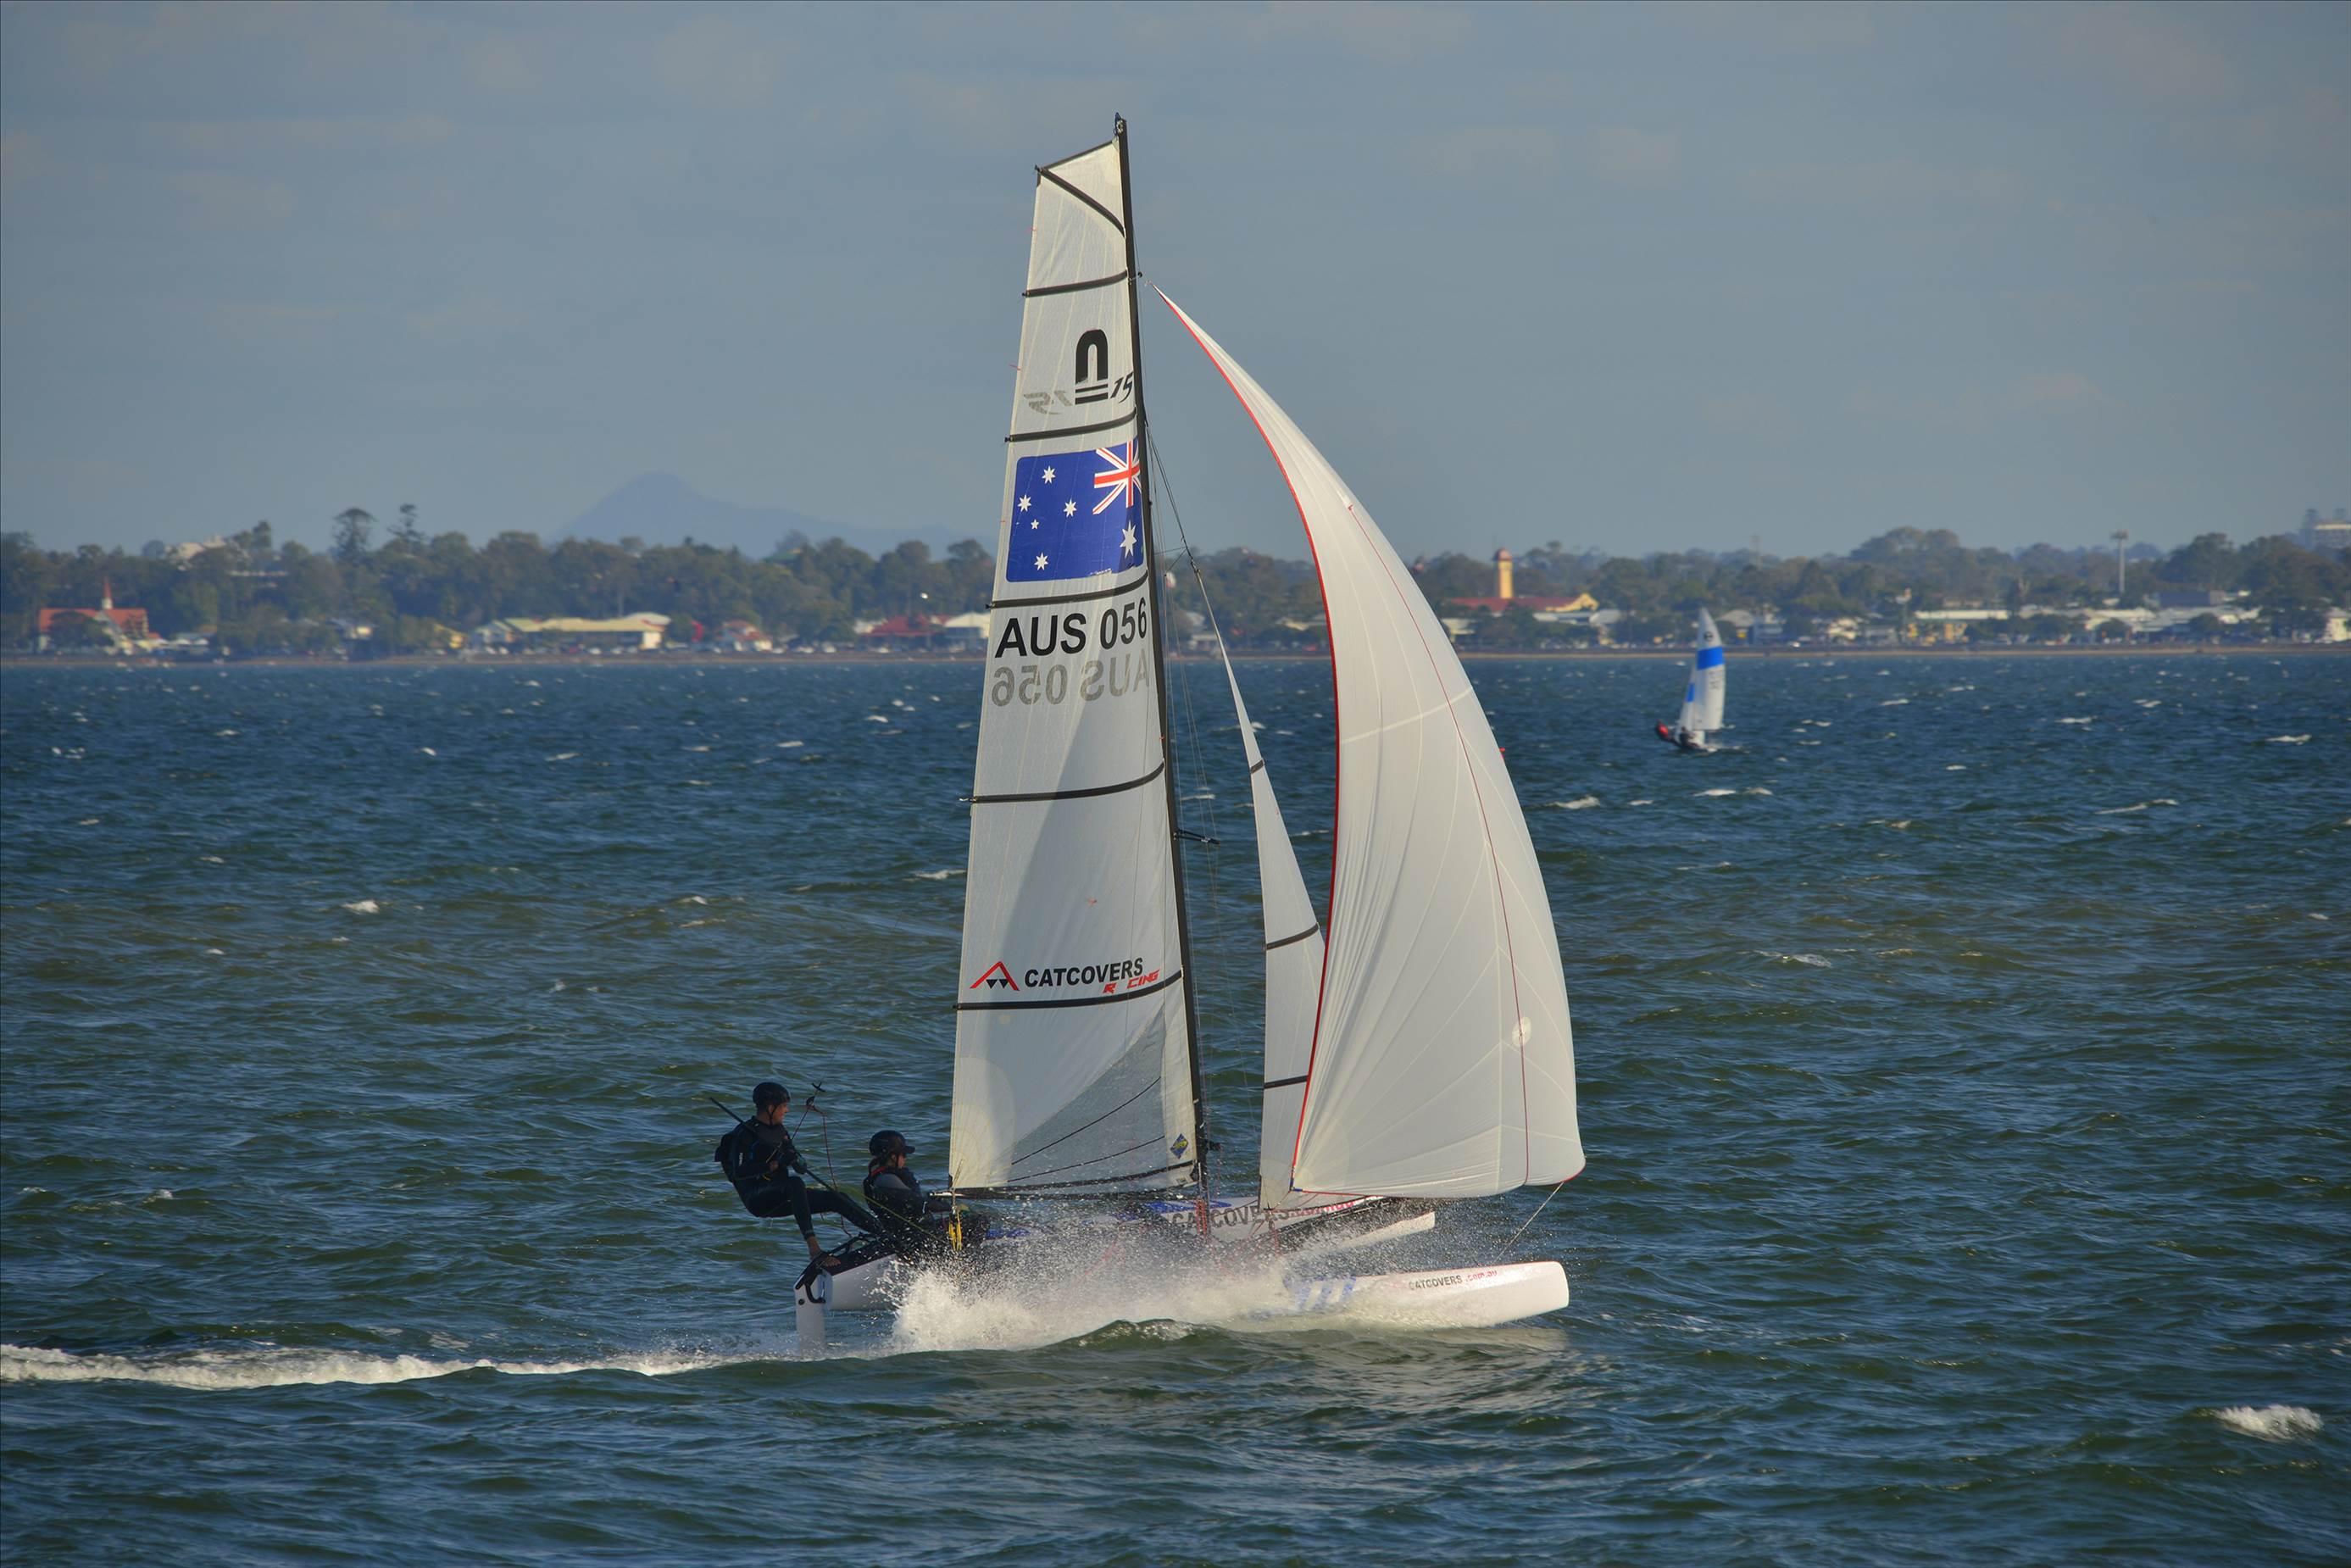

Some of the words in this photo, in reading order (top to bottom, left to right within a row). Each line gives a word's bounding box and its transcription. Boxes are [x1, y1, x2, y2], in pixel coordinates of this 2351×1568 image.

[1110, 371, 1134, 404] 15
[994, 612, 1087, 659] AUS
[1099, 596, 1148, 650] 056
[1024, 957, 1144, 988] CATCOVERS
[1409, 1275, 1464, 1291] CATCOVERS
